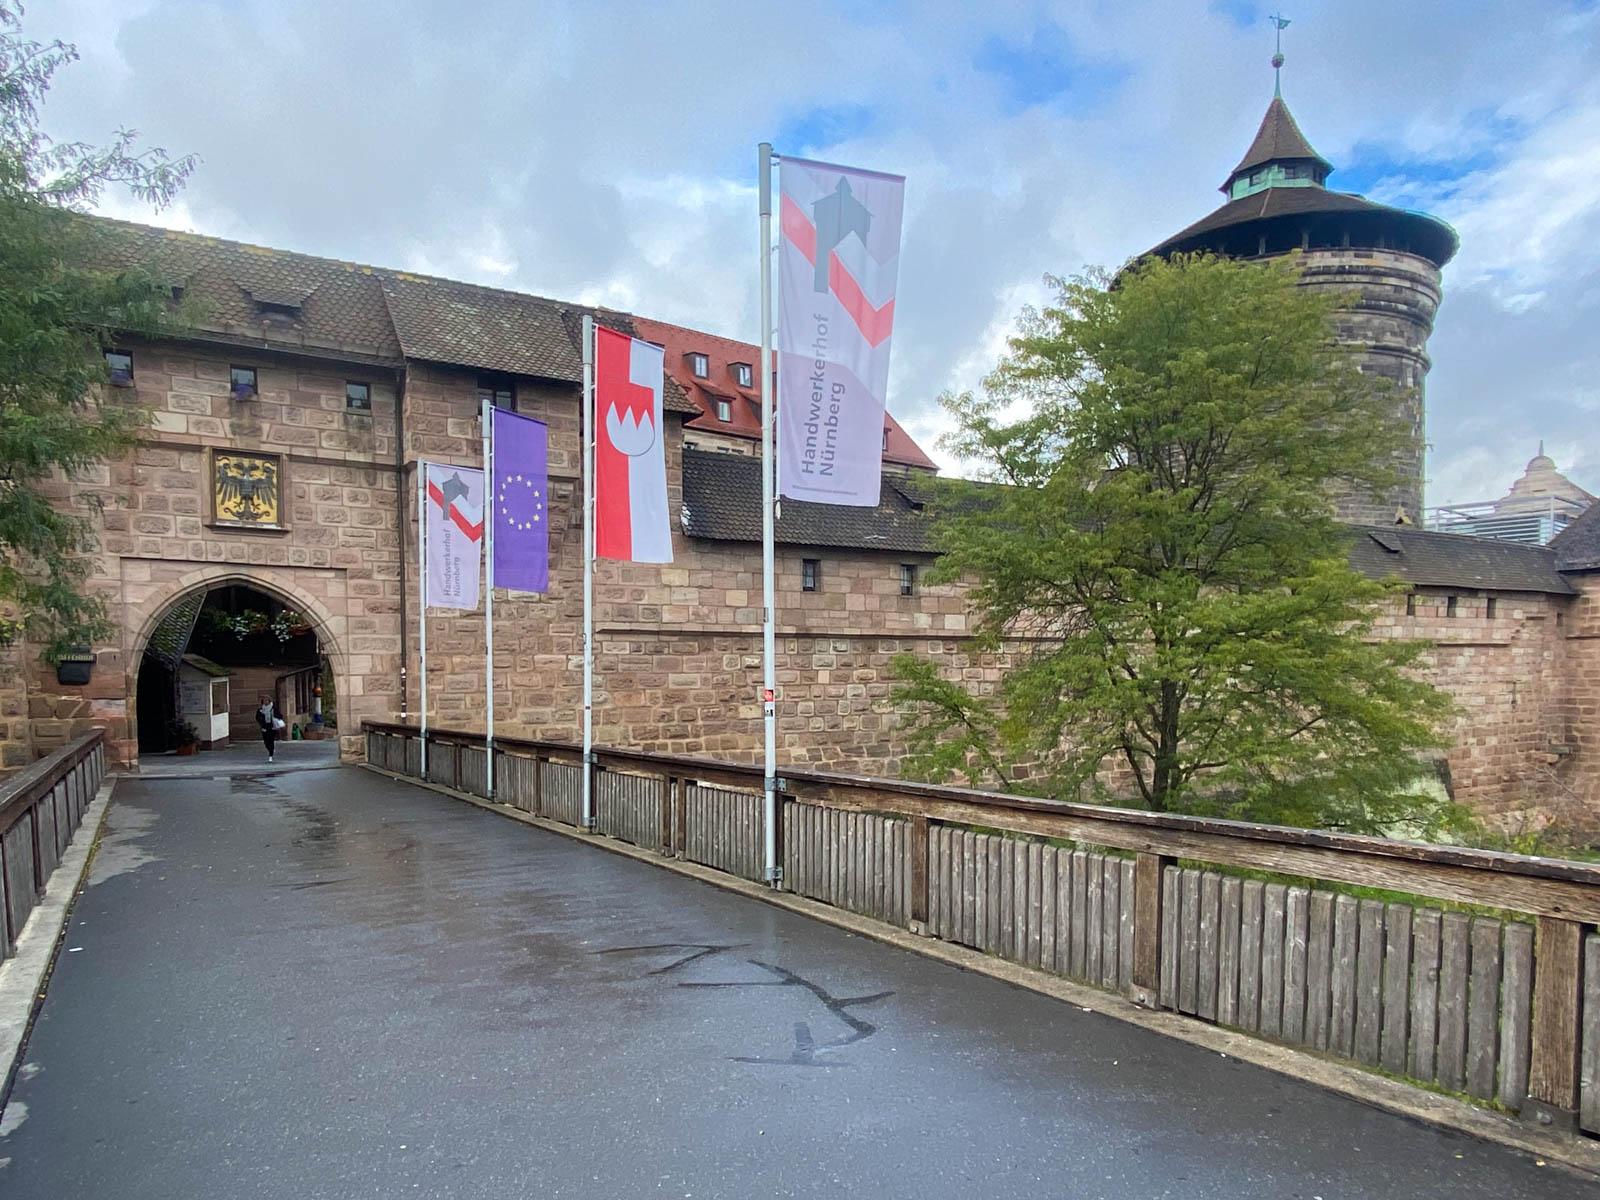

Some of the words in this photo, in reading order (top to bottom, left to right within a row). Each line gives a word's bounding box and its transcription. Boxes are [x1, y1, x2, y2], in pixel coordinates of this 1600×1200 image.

[801, 312, 829, 475] Handwerkerhof
[819, 382, 845, 477] Nürnberg
[442, 528, 452, 597] Handwerkerhof
